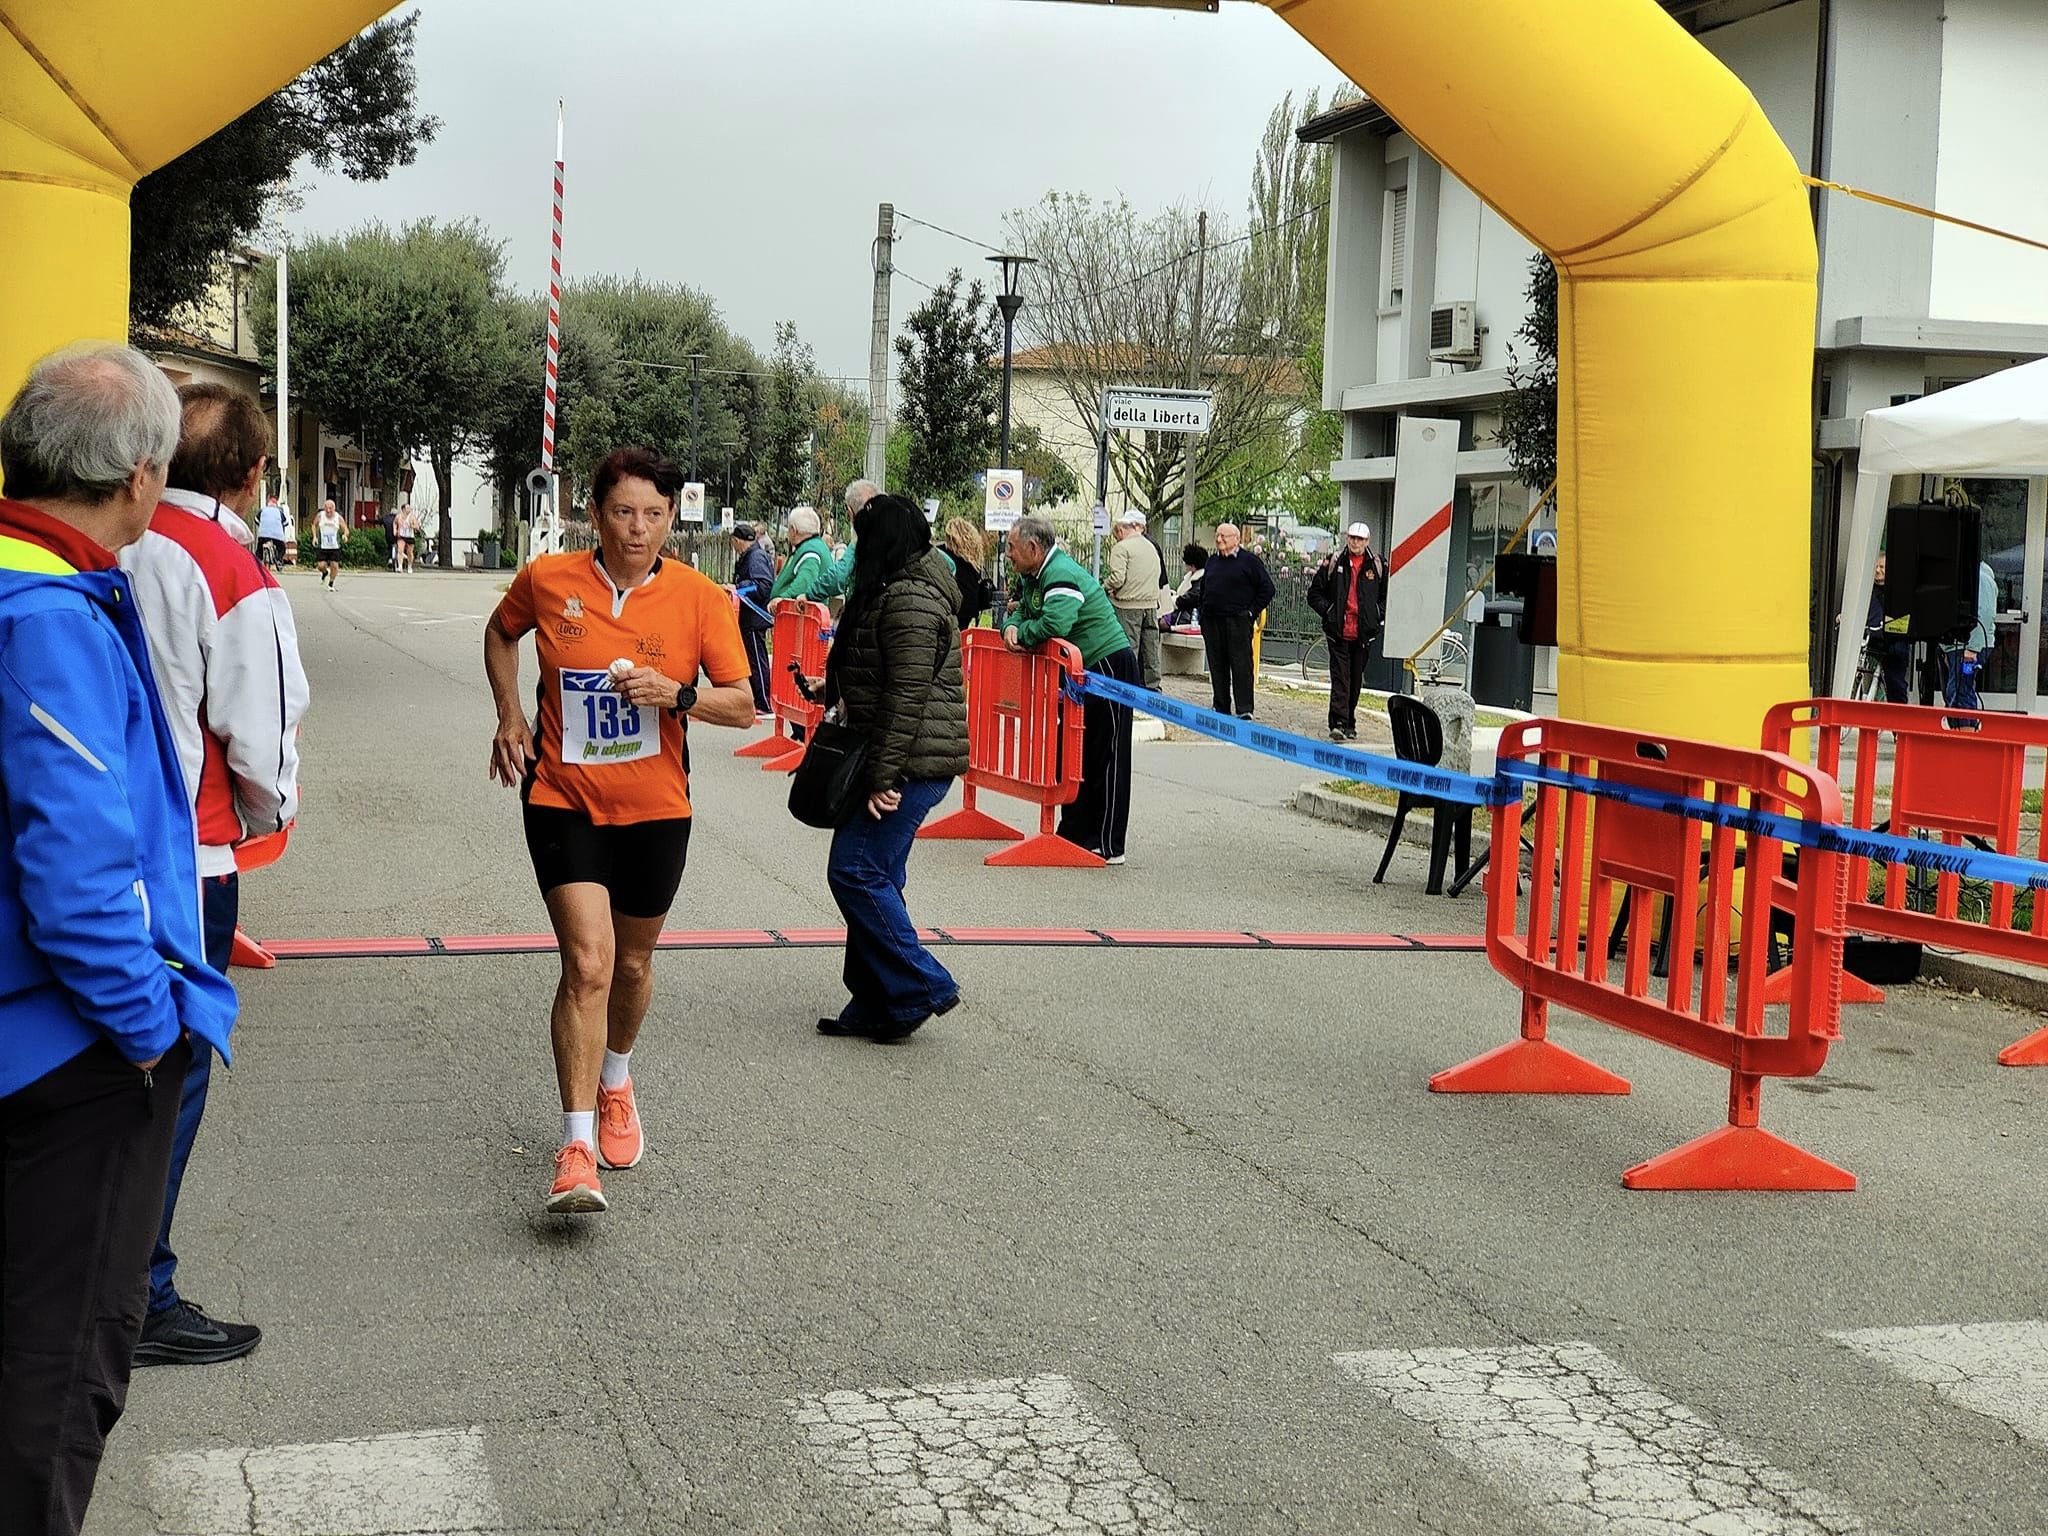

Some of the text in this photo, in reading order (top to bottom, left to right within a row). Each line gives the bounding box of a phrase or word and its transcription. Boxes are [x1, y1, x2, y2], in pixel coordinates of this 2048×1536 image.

[1114, 407, 1146, 422] della
[559, 624, 582, 636] LUCCI
[582, 694, 640, 739] 133
[1850, 839, 1900, 863] TUBAZIONI
[1903, 848, 1973, 875] ATTENZIONE
